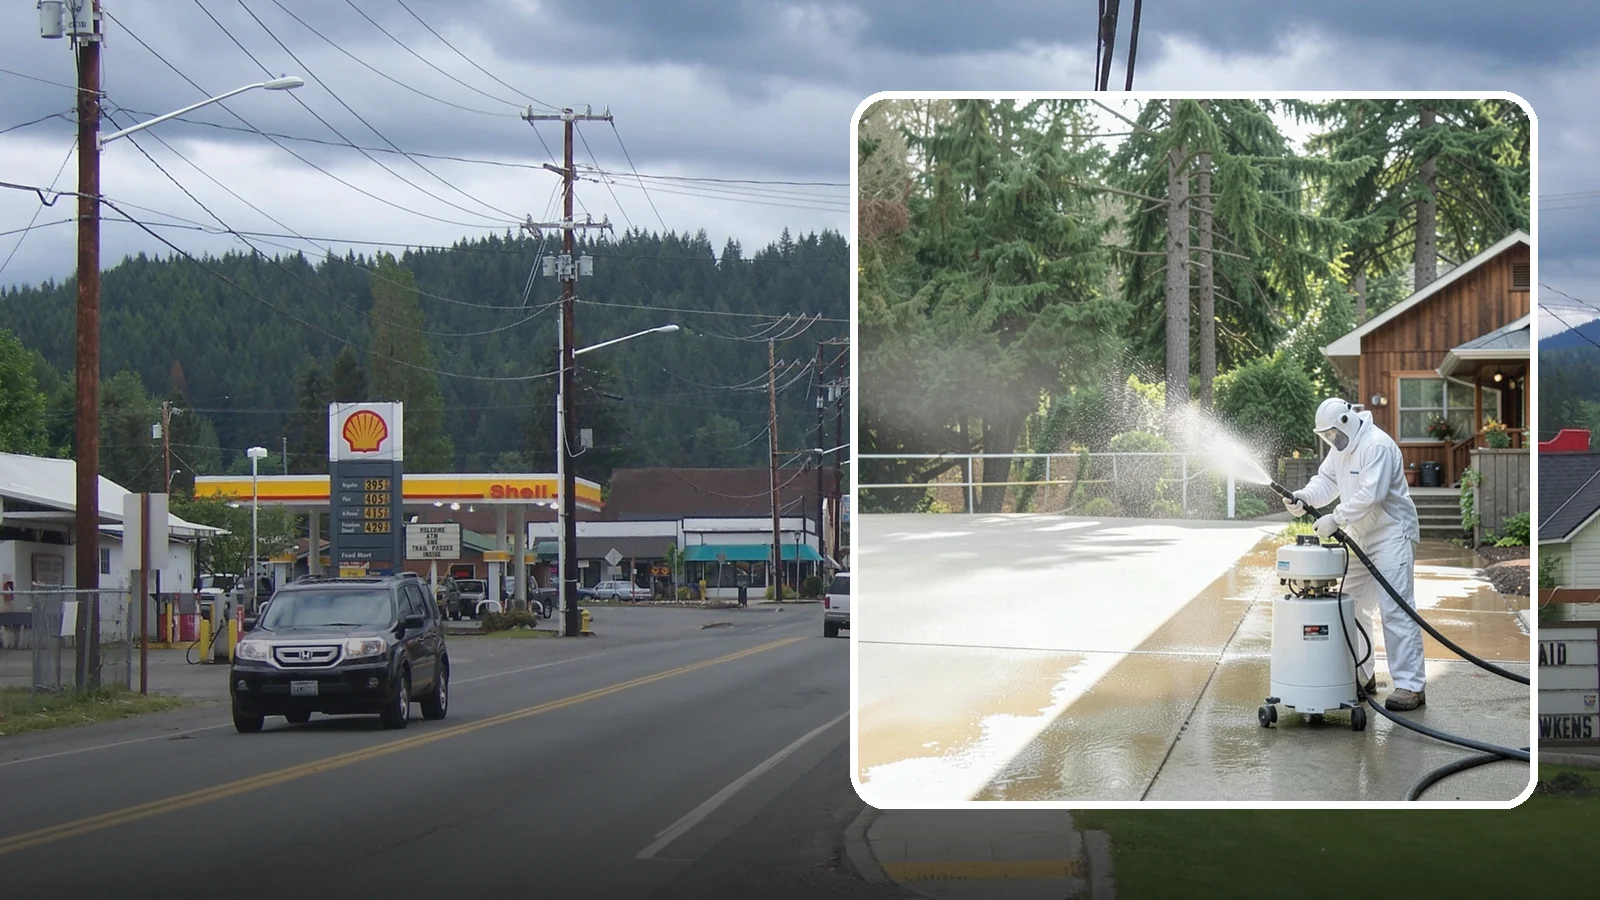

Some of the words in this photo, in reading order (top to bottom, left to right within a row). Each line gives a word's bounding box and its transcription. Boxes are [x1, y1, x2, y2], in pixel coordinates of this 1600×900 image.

[490, 484, 547, 499] Shell
[1538, 643, 1566, 665] AID
[1538, 716, 1592, 738] WKENS
